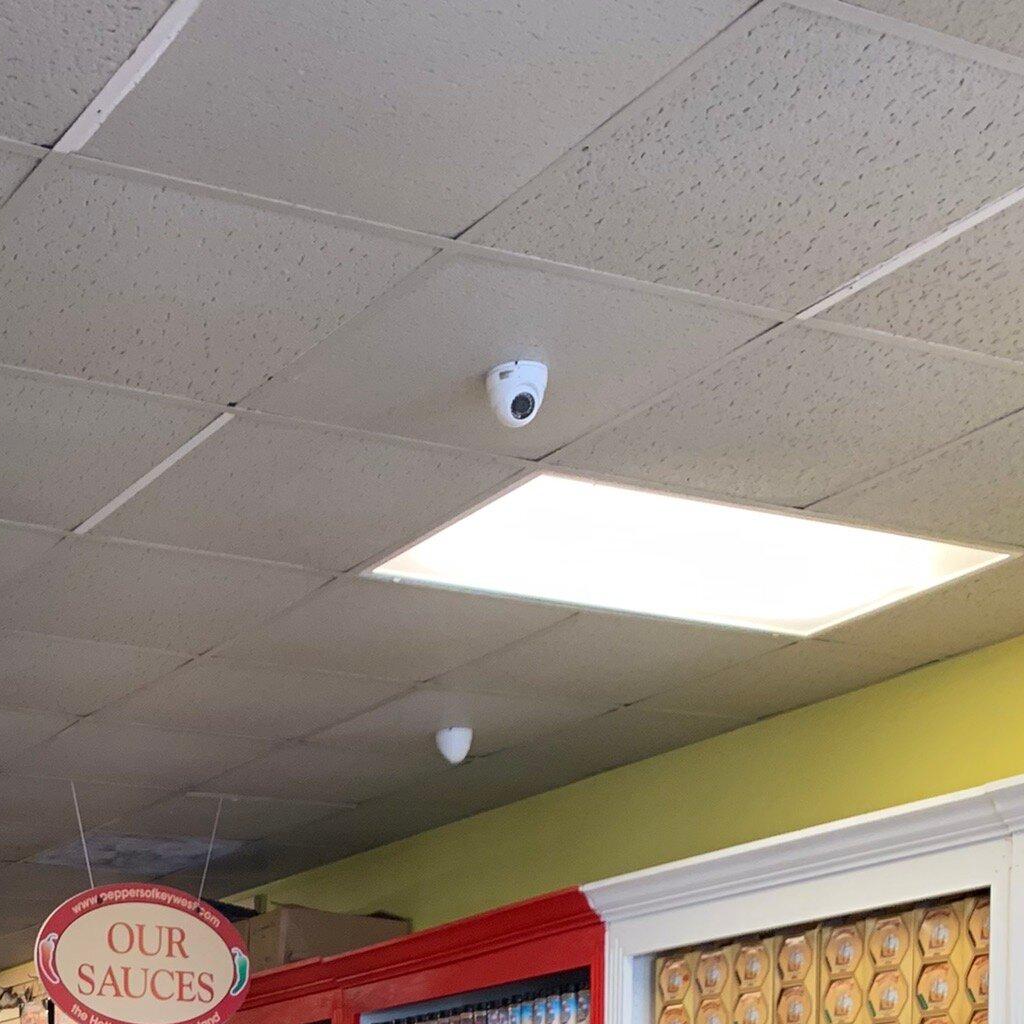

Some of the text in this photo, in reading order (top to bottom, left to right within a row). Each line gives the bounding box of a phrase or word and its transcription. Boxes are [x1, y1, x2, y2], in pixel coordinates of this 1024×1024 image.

[107, 921, 190, 959] OUR
[77, 963, 215, 1003] SAUCES
[71, 1004, 88, 1022] the
